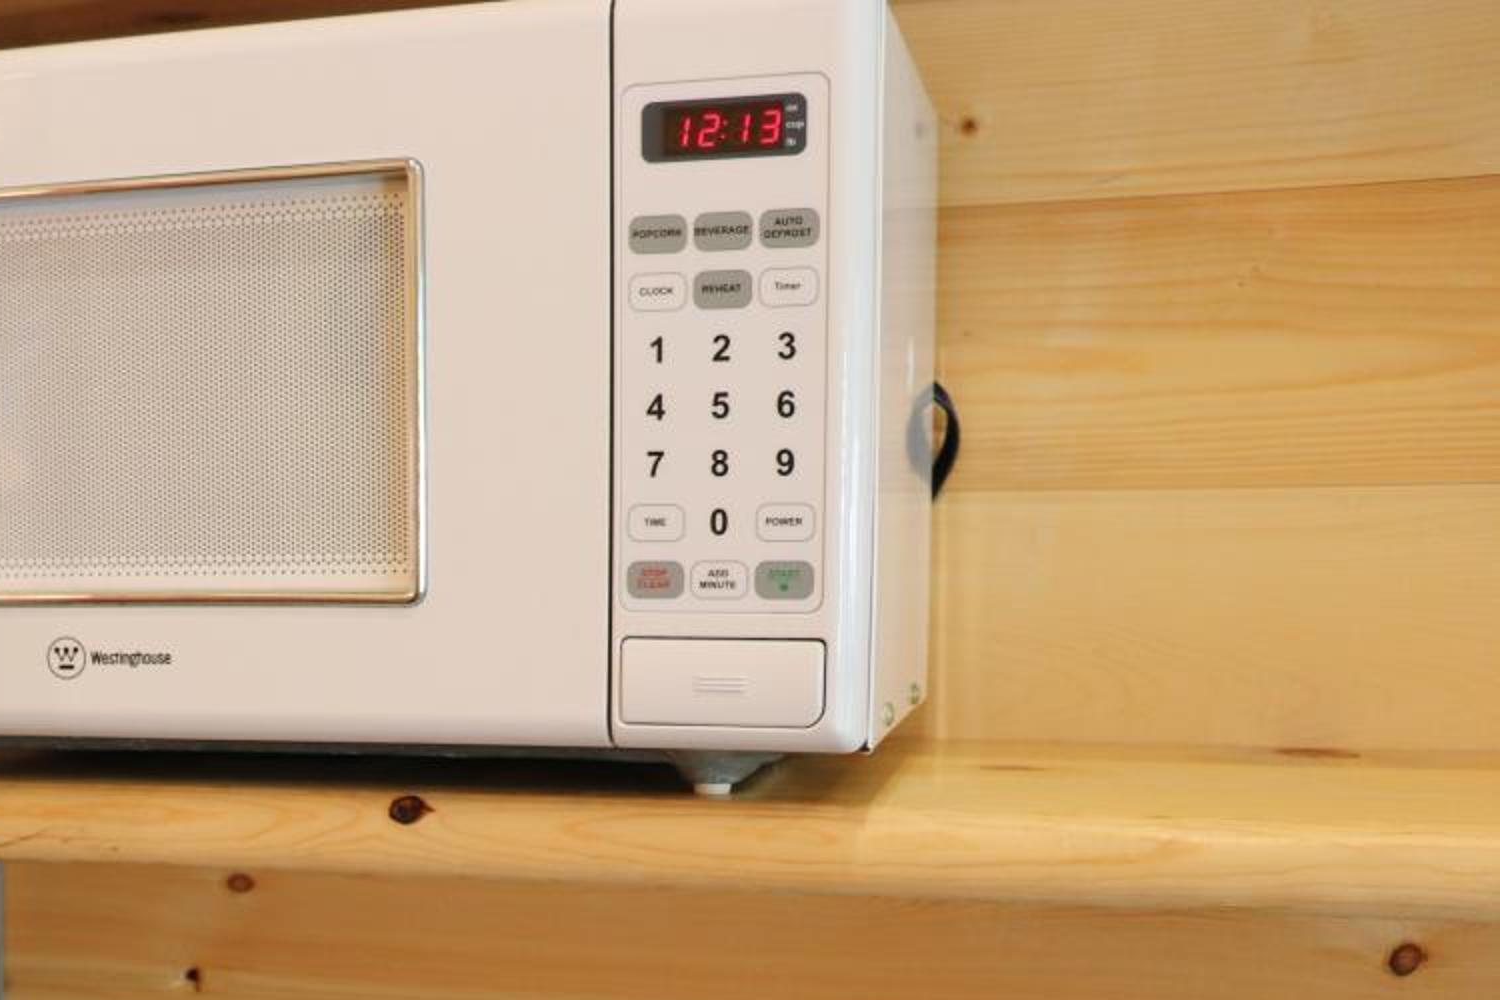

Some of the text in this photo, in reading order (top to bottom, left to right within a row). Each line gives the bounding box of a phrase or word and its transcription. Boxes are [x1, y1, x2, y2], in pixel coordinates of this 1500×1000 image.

[680, 109, 781, 147] 12:13
[775, 215, 803, 226] AUTO
[632, 228, 682, 239] POPCORN
[694, 225, 749, 236] BEVERAGE
[763, 227, 811, 239] DEFROST
[639, 286, 673, 297] CLOCK
[701, 283, 741, 294] REHEAT
[650, 332, 796, 363] 1 2 3
[646, 390, 795, 420] 4 5 6
[647, 448, 795, 477] 7 8 9
[710, 508, 728, 535] 0
[765, 516, 802, 527] POWER
[699, 581, 736, 589] MINUTE
[91, 651, 171, 668] Westinghouse
